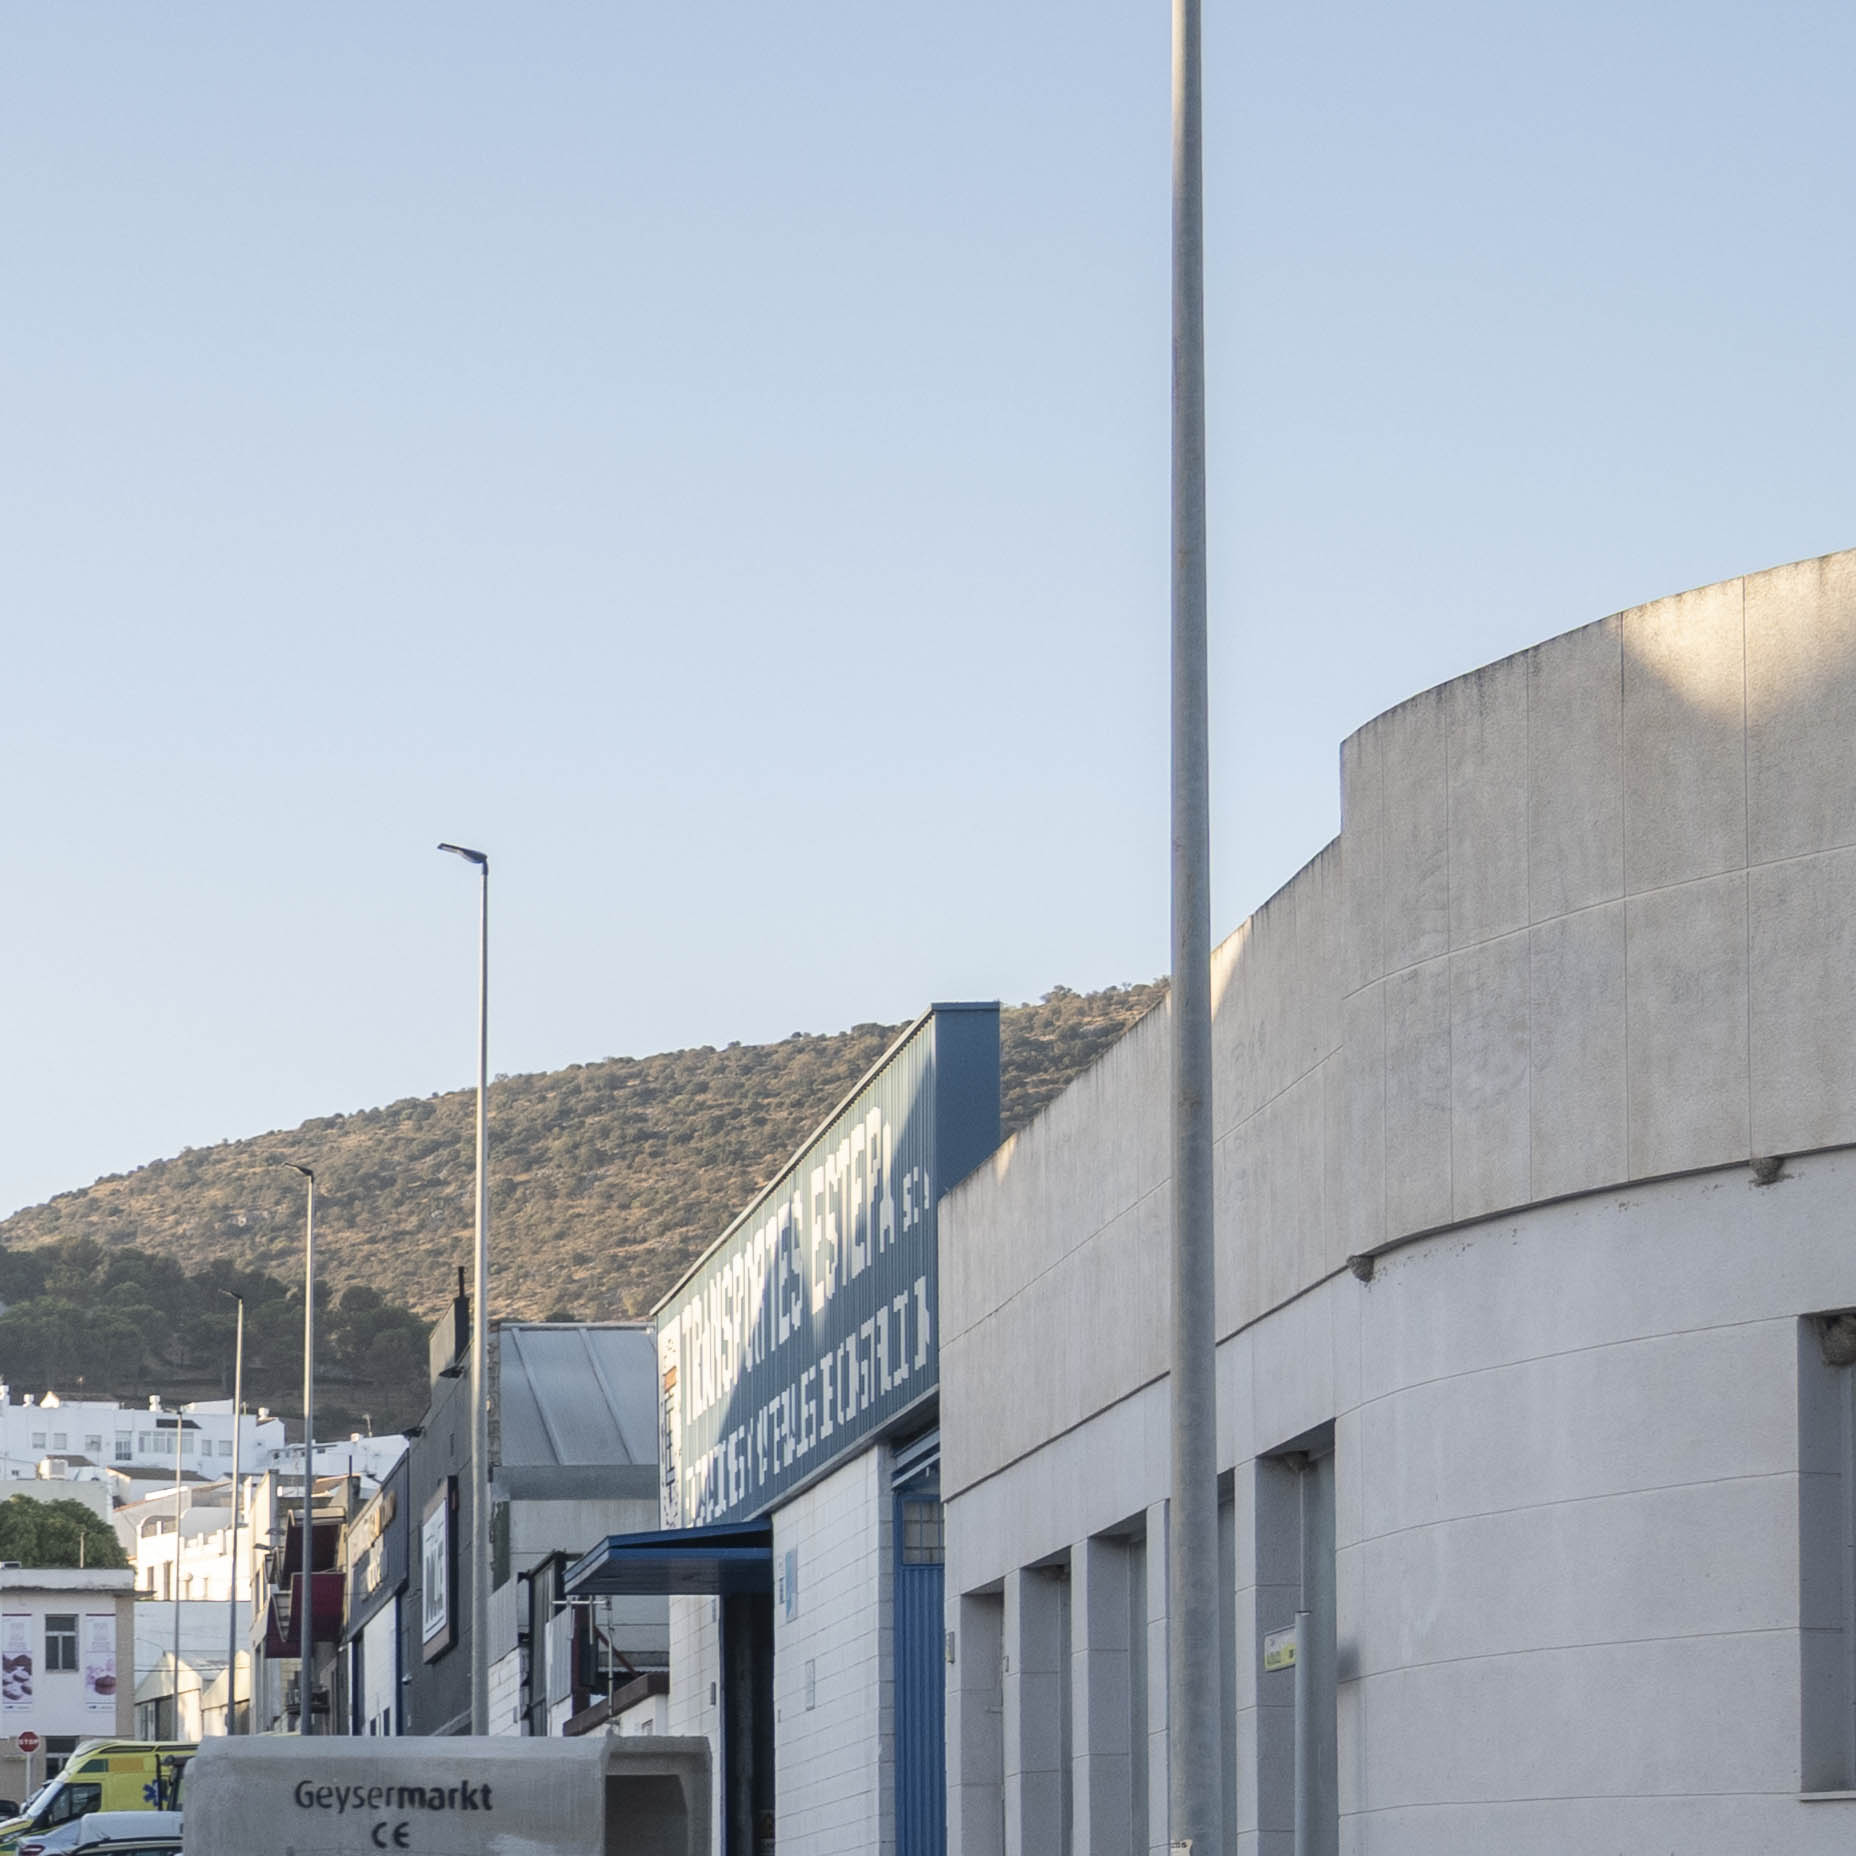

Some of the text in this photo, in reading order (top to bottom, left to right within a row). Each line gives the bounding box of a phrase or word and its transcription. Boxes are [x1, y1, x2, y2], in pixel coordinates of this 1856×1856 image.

[811, 1106, 896, 1315] ESTEPA
[294, 1779, 494, 1815] Geysermarkt
[371, 1821, 411, 1849] CE
